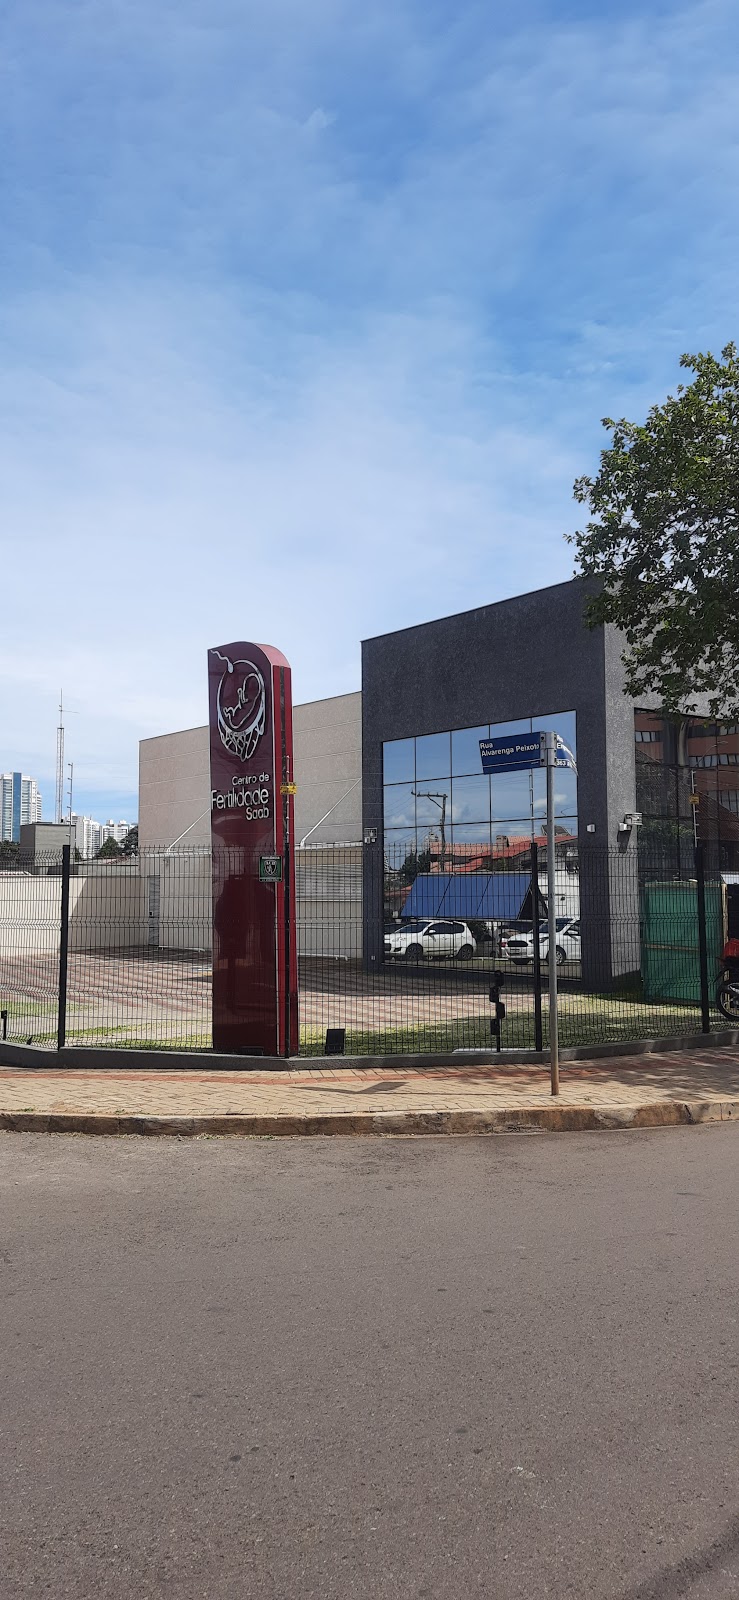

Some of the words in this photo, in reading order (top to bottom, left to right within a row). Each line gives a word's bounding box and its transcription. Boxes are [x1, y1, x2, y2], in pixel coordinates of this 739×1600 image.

[481, 747, 514, 757] Alvarenga
[515, 744, 539, 752] Peixoto
[232, 775, 257, 785] Centro
[259, 772, 270, 782] de
[211, 785, 269, 810] Fertilidade
[246, 806, 269, 820] Saab
